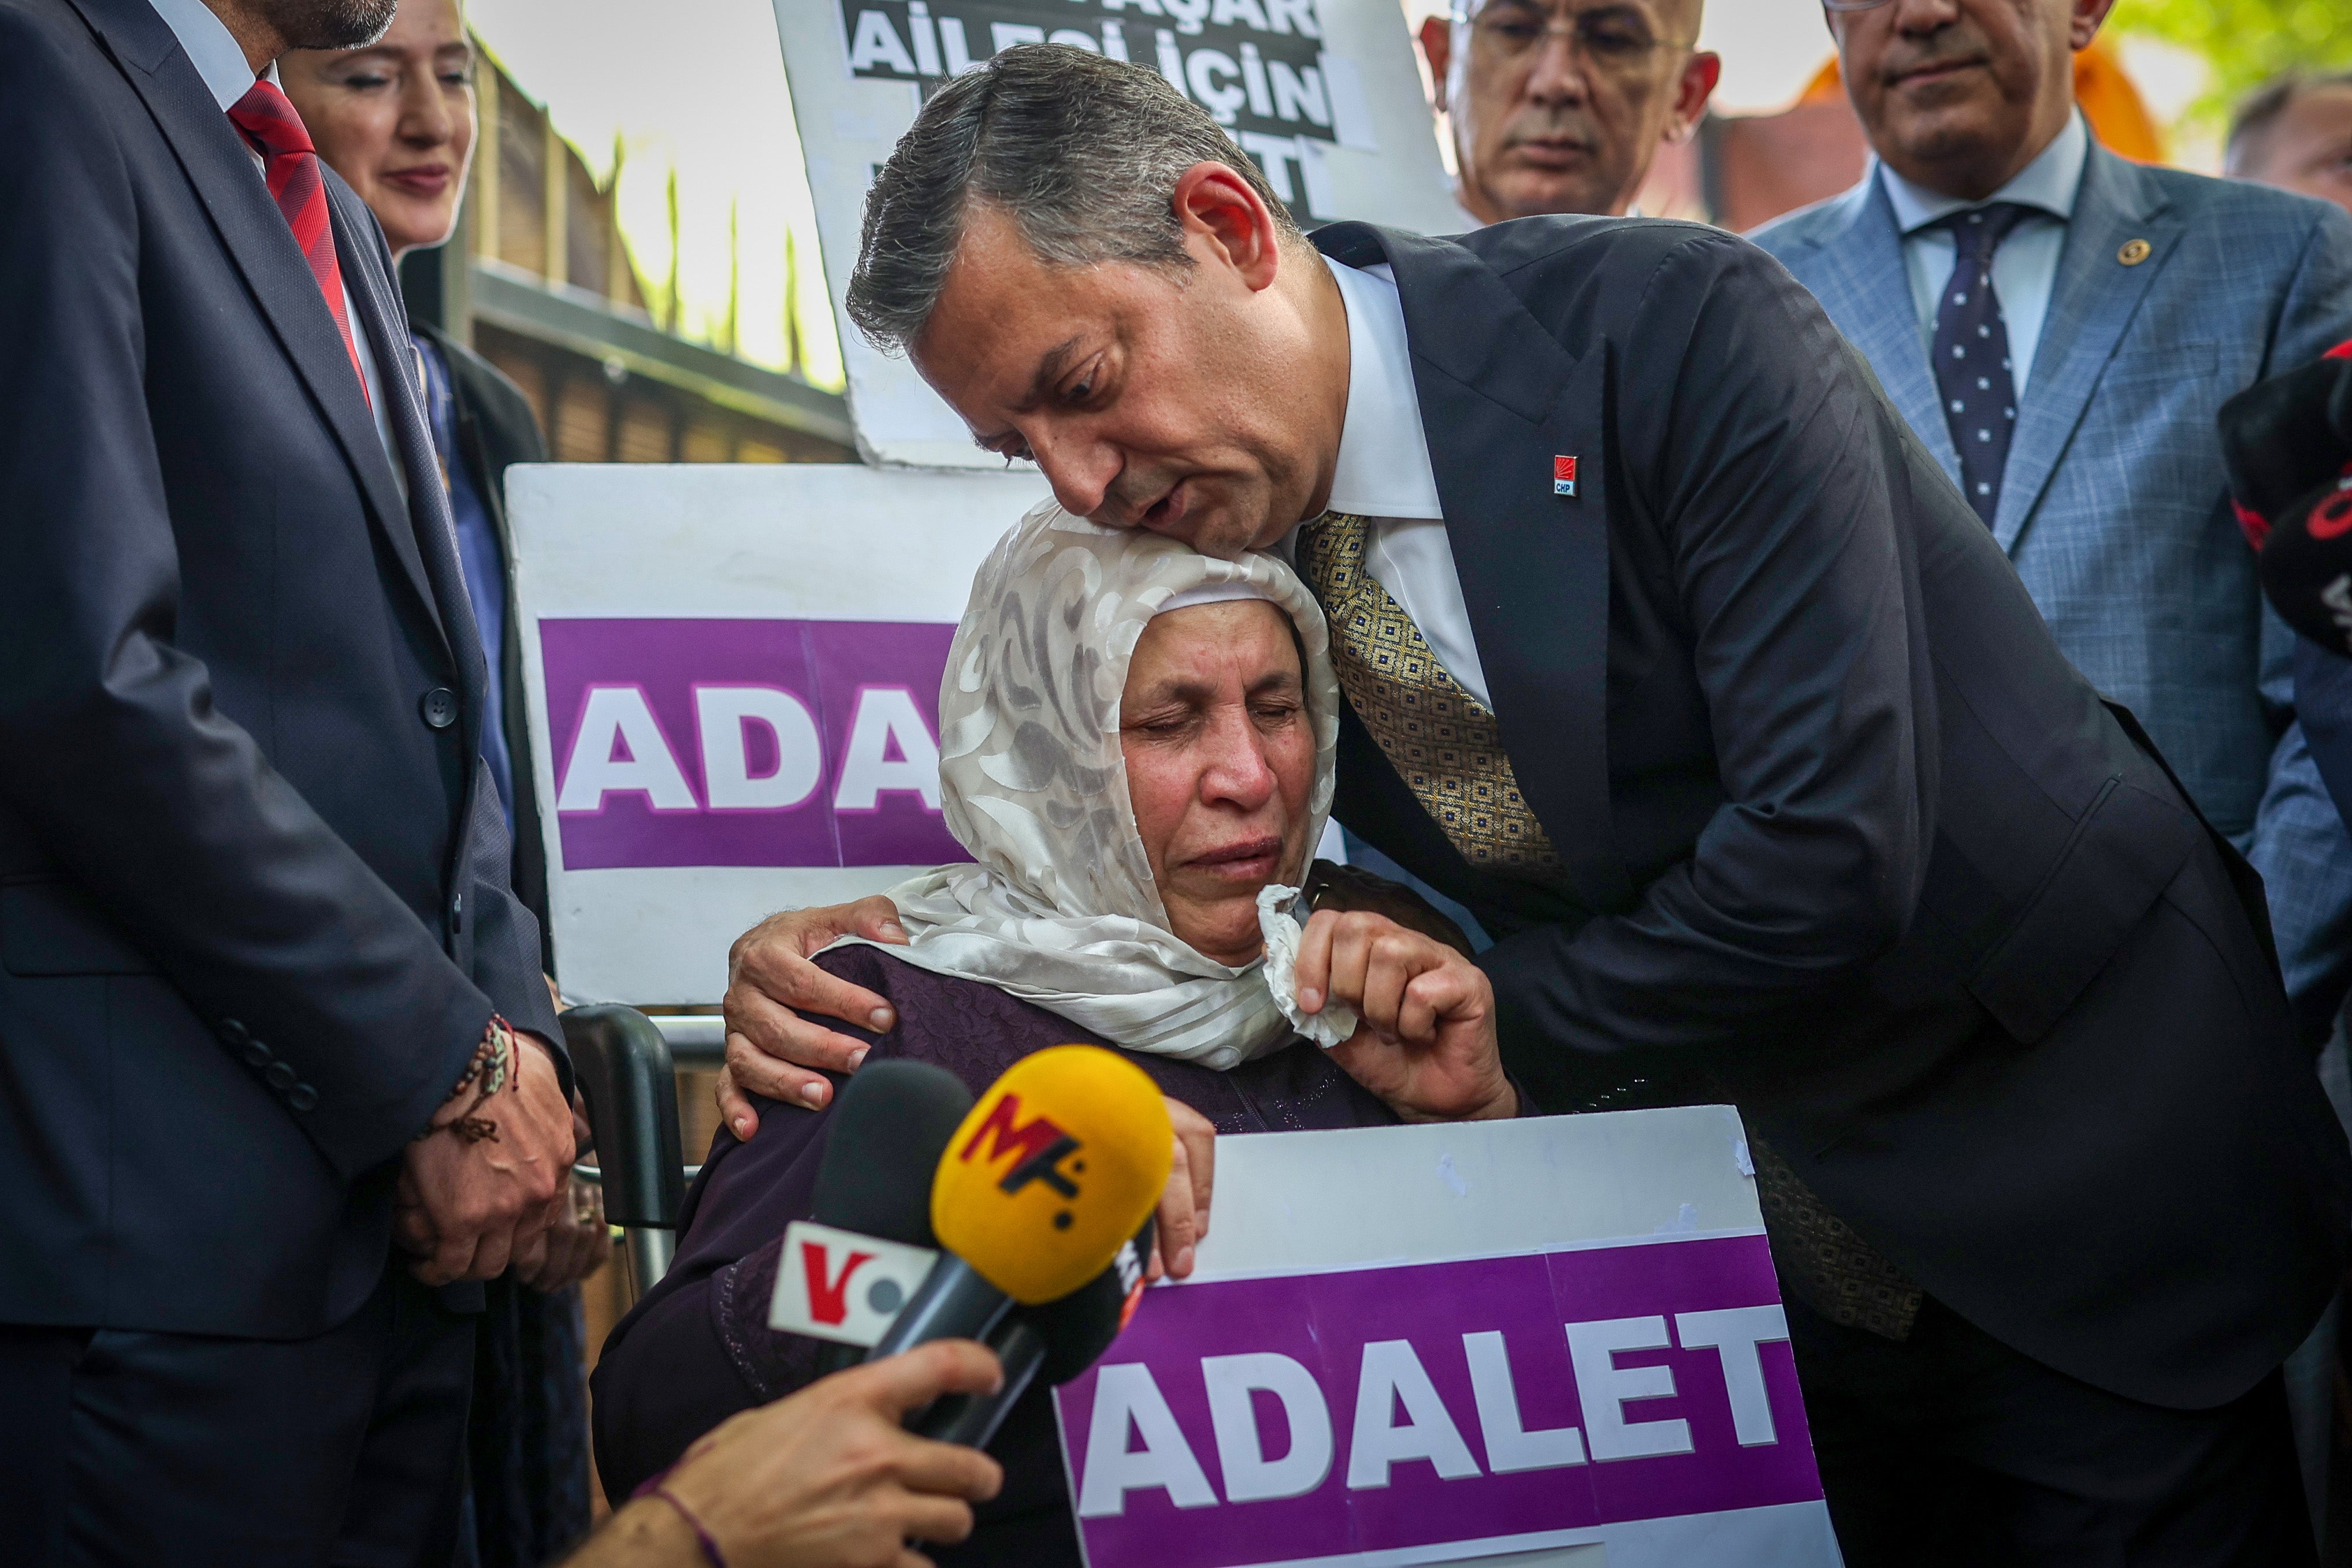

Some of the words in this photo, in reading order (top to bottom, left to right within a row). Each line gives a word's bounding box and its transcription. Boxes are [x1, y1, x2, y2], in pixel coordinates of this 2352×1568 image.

[1155, 28, 1331, 127] İÇİN
[1556, 483, 1570, 493] CHP
[1077, 1304, 1789, 1517] ADALET
